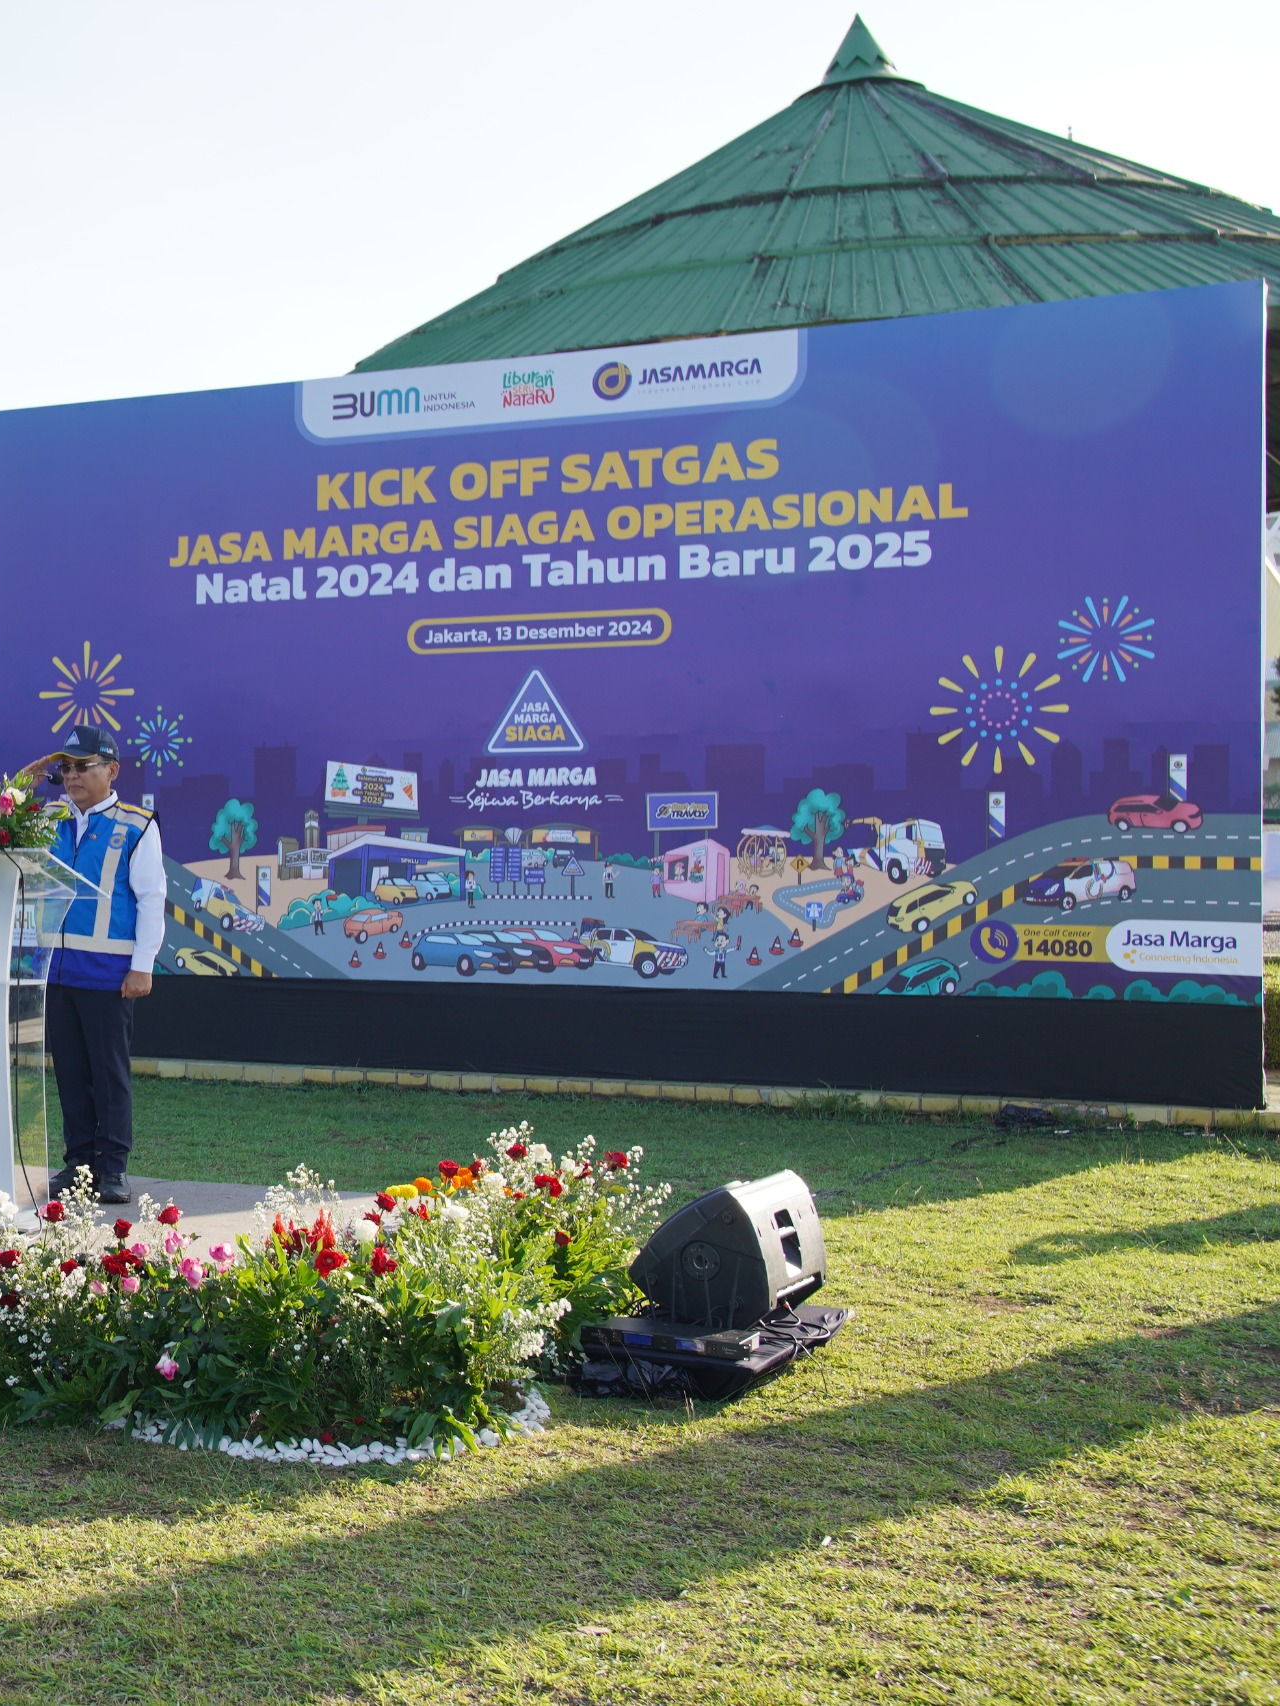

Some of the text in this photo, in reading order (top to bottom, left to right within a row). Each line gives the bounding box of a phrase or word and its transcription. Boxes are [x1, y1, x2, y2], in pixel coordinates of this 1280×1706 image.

[638, 357, 762, 385] JASAMARGA
[423, 392, 456, 402] UNTUK
[423, 401, 475, 412] INDONESIA
[316, 439, 779, 511] KICK OFF SATGAS
[169, 483, 968, 567] JASA MARGA SIAGA OPERASIONAL
[196, 529, 932, 605] Natal 2024 dan Tahun Baru 2025
[424, 620, 652, 644] Jakarta, 13 Desember 2024
[521, 702, 550, 712] JASA
[514, 713, 556, 724] MARGA
[505, 724, 566, 742] SIAGA
[475, 766, 596, 788] JASA MARGA
[363, 783, 384, 791] 2024
[362, 796, 382, 804] 2025
[466, 788, 602, 812] Sejiwa Berkarya
[671, 810, 708, 818] TRAVOY
[1023, 928, 1091, 938] One Call Center
[1122, 929, 1237, 953] Jasa Marga
[1023, 938, 1092, 958] 14080
[1138, 952, 1238, 964] Connecting Indonesia
